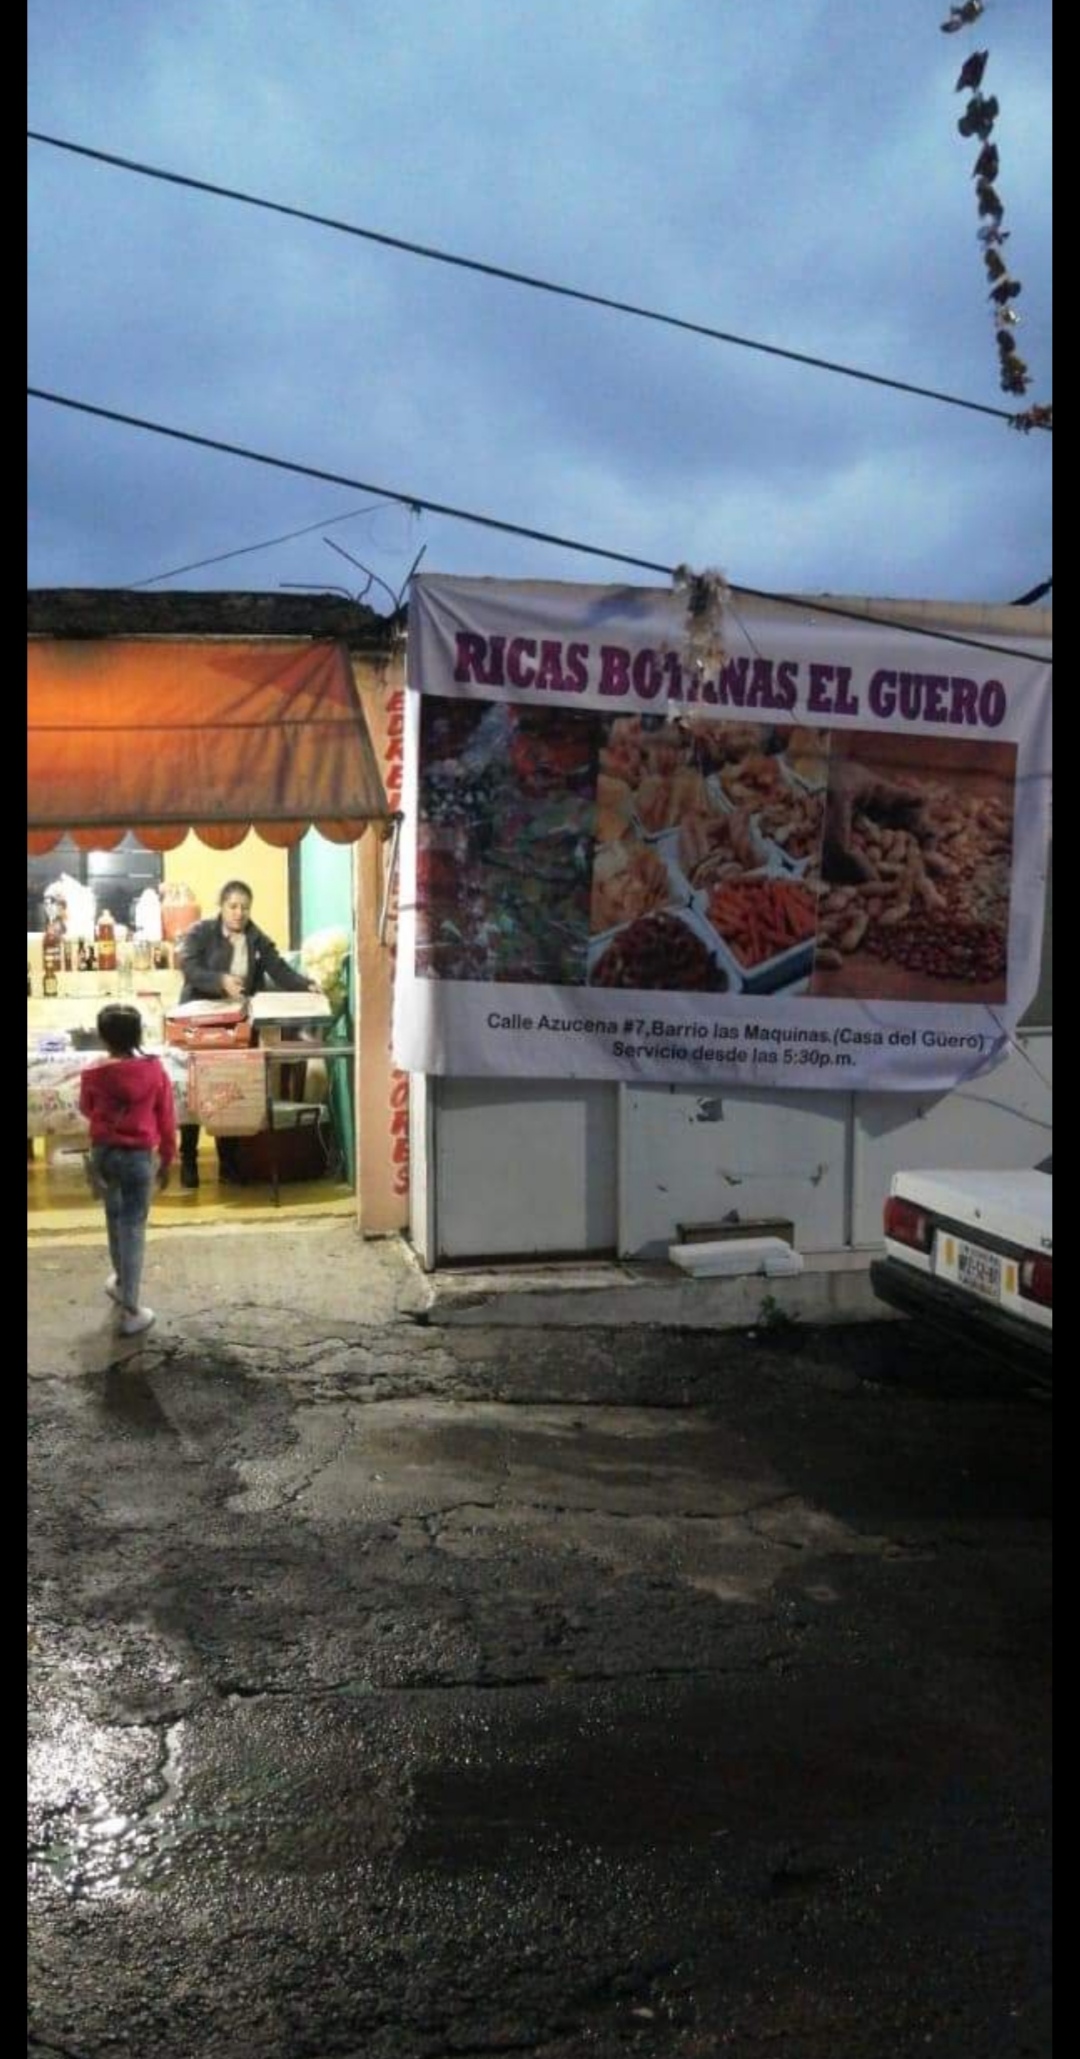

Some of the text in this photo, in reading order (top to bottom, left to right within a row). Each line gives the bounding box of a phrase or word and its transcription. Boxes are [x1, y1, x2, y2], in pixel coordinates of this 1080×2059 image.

[454, 631, 589, 694] RICAS
[807, 663, 858, 716] EL
[868, 668, 1007, 728] GUERO
[487, 1012, 534, 1030] Calle
[538, 1015, 618, 1034] Azucena
[714, 1023, 739, 1039] las
[888, 1030, 916, 1046] del
[612, 1041, 856, 1068] Servicio desde las 5:30p.m.
